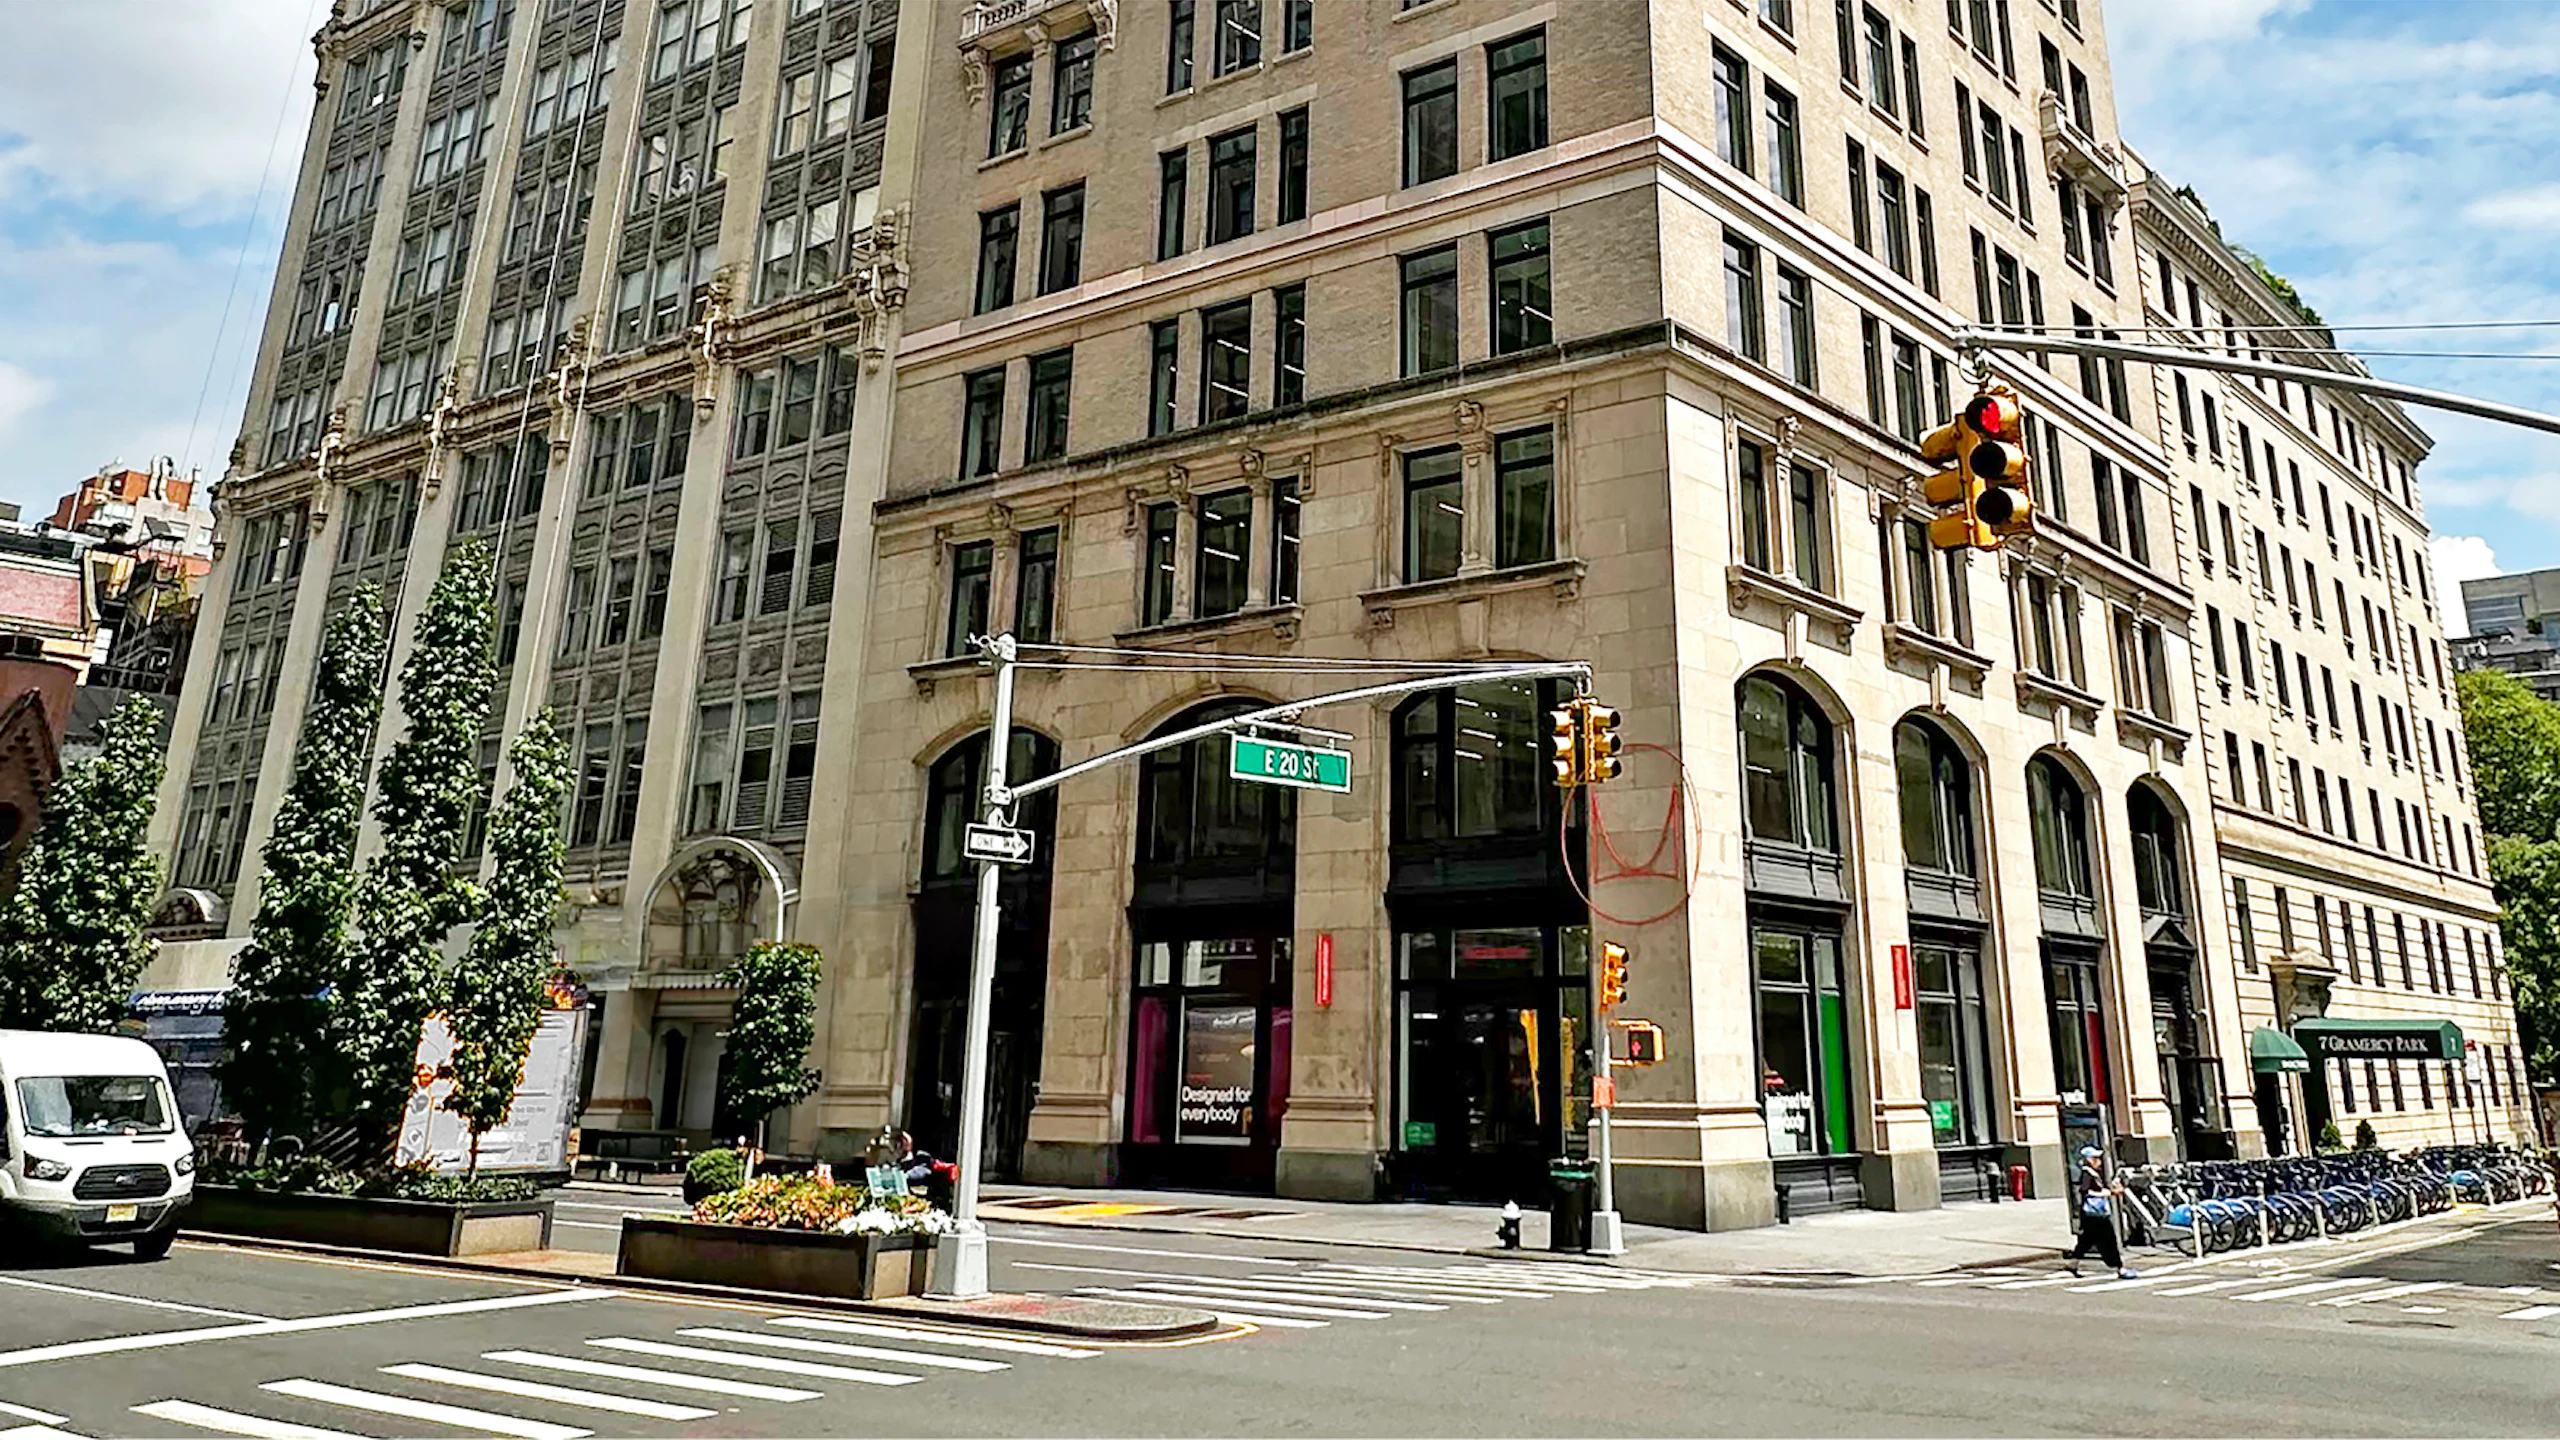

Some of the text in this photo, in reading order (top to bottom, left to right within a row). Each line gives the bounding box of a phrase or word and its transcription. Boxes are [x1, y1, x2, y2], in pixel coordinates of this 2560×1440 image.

[1265, 749, 1320, 780] E 20 St
[976, 836, 1026, 850] ONE WAY
[2318, 1035, 2429, 1053] 7 GRAMERCY PARK
[1181, 1085, 1252, 1106] Designed for
[1180, 1105, 1240, 1124] everybody
